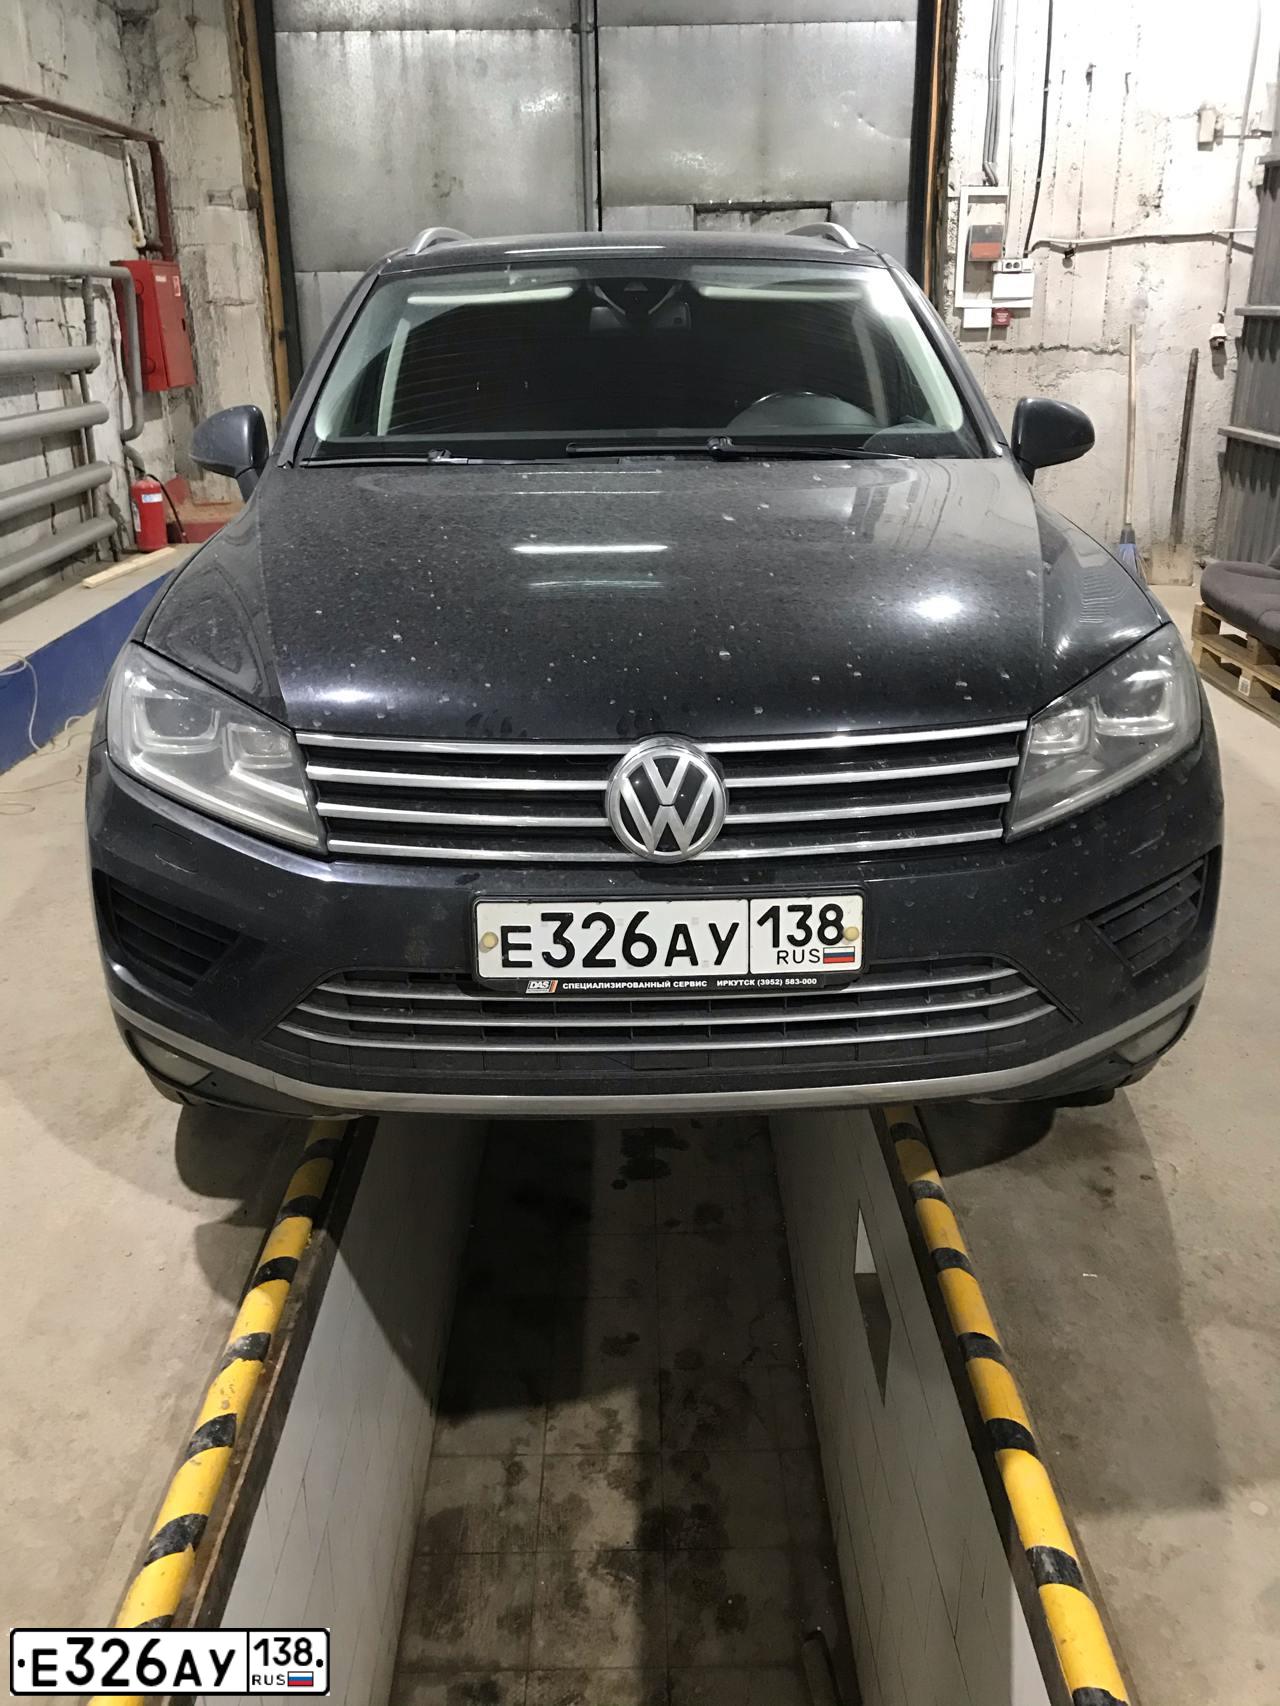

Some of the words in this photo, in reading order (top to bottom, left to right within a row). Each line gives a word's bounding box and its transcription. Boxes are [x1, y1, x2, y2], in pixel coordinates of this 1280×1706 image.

[500, 910, 740, 969] Е326АУ
[756, 903, 844, 949] 138
[776, 948, 821, 965] RUS
[529, 980, 550, 989] DAS
[562, 980, 671, 990] СПЕЦИАЛИЗИРОВАННЫЙ
[673, 980, 708, 988] СЕРВИС
[716, 979, 756, 987] ИРКУТСК
[757, 978, 783, 987] (3952)
[784, 978, 817, 986] 583-000
